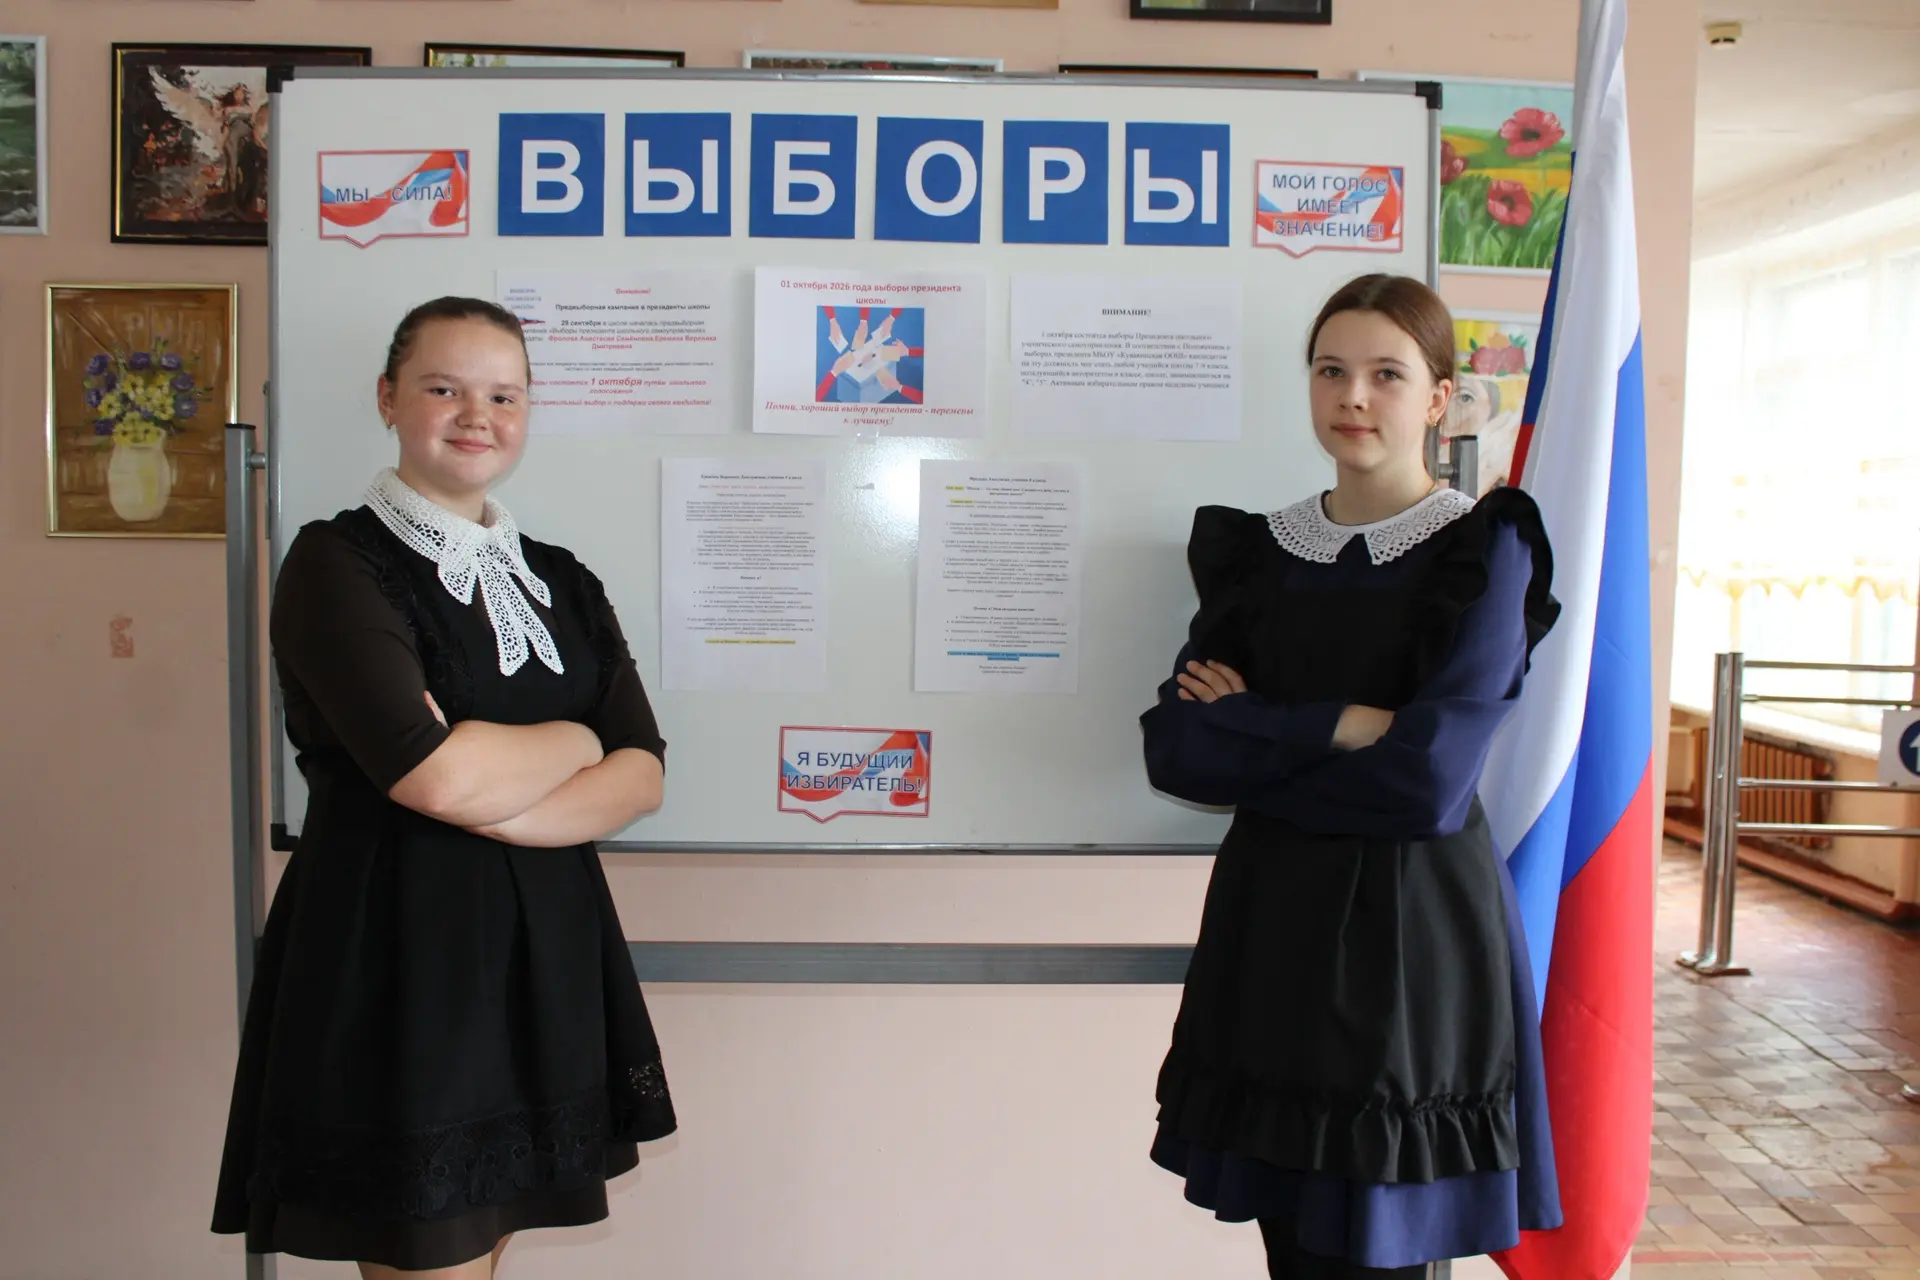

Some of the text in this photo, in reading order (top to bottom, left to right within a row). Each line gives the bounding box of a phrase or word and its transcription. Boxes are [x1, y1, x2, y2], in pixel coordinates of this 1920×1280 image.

[521, 139, 1218, 225] ВЫБОРЫ
[1323, 176, 1387, 193] ГОЛОС
[336, 187, 369, 202] МЫ
[392, 186, 452, 201] СИЛА!
[1298, 198, 1361, 214] ИМЕЕТ
[1275, 221, 1384, 238] ЗНАЧЕНИЕ!
[793, 281, 828, 291] октября
[852, 284, 872, 292] года
[874, 283, 909, 293] выборы
[911, 284, 962, 293] президента
[856, 297, 887, 305] школы
[598, 376, 643, 387] октября
[800, 404, 839, 414] хороший
[841, 404, 868, 414] выбор
[870, 406, 922, 415] президента
[930, 408, 974, 416] перемены
[797, 751, 810, 766] Я
[787, 774, 922, 792] ИЗБИРАТЕЛЬ!
